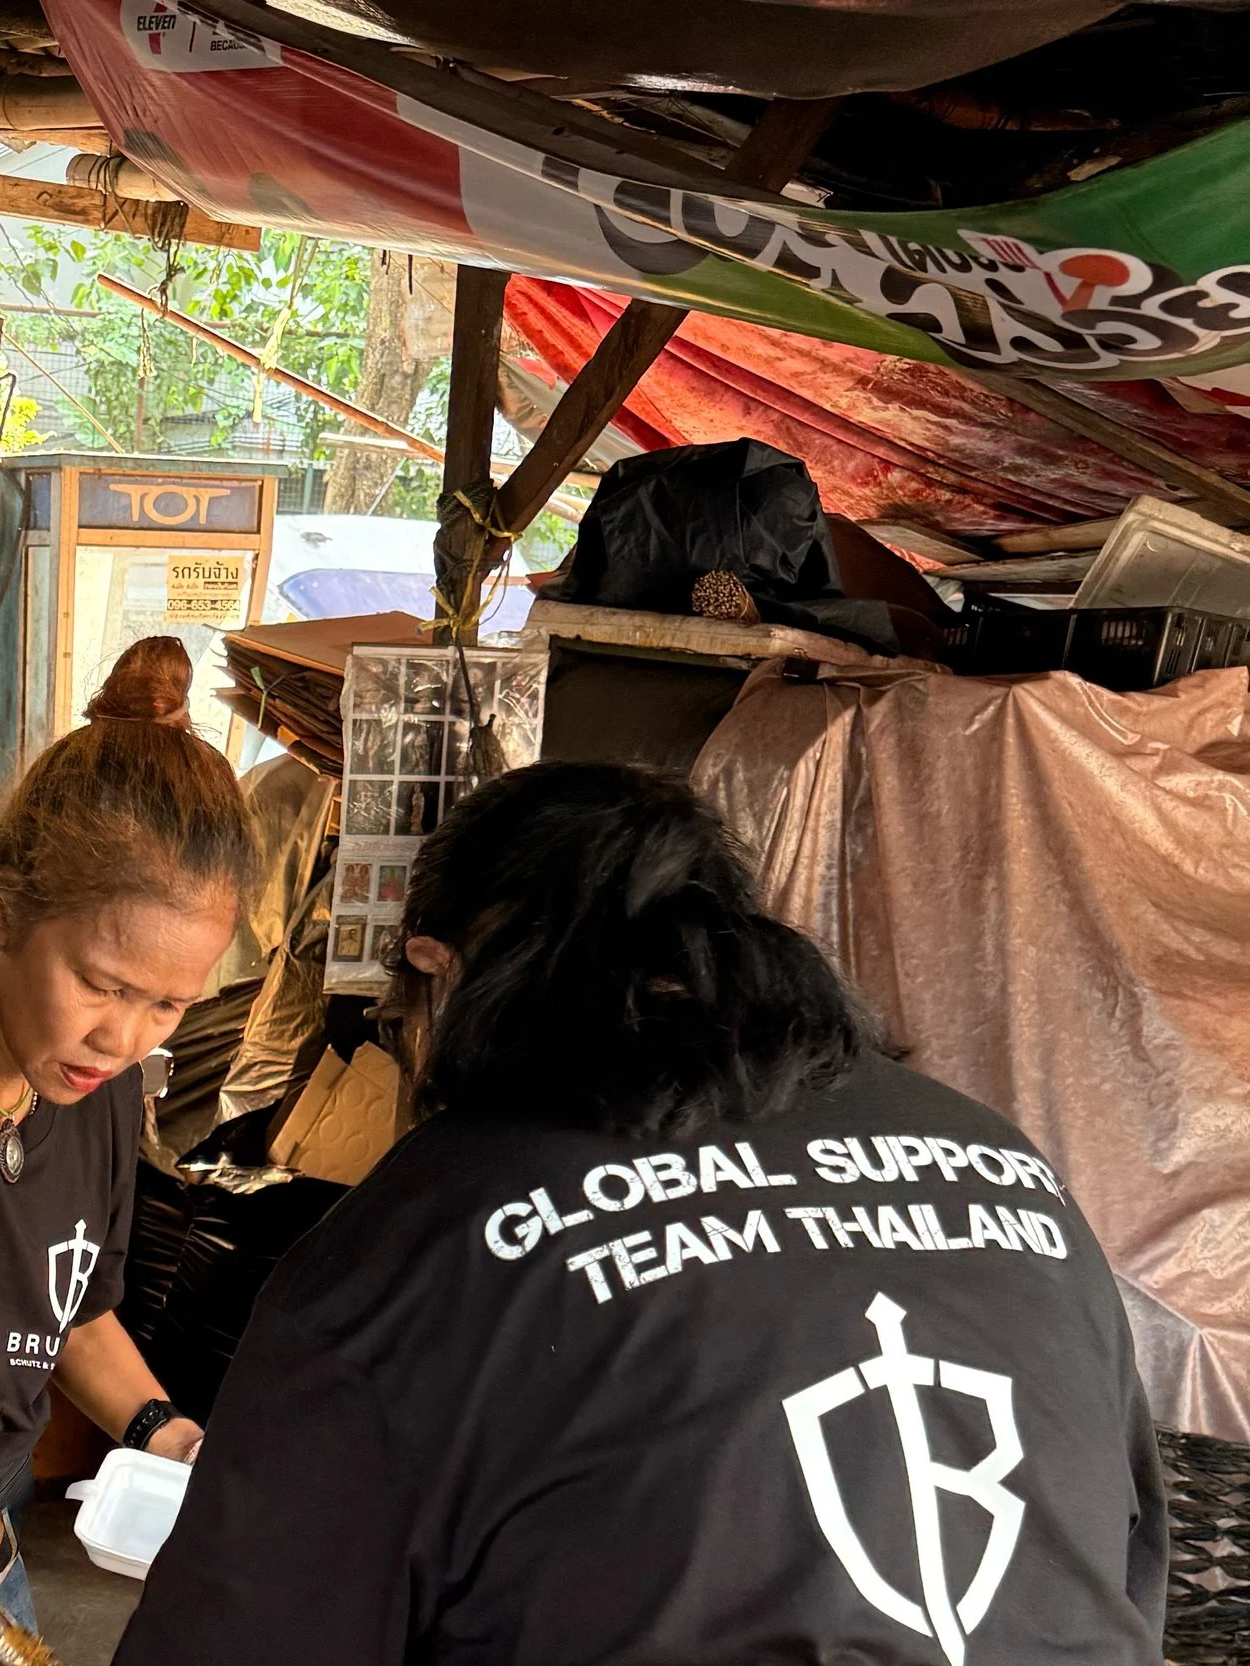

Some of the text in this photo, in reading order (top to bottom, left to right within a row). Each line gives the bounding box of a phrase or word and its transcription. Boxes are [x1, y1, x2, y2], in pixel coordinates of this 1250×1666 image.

[210, 40, 248, 51] BECAU
[109, 483, 231, 526] TOT
[172, 561, 239, 580] รถรับจ้าง
[484, 1141, 798, 1261] GLOBAL
[565, 1203, 1068, 1305] TEAM THAILAND
[6, 1331, 61, 1357] BRU
